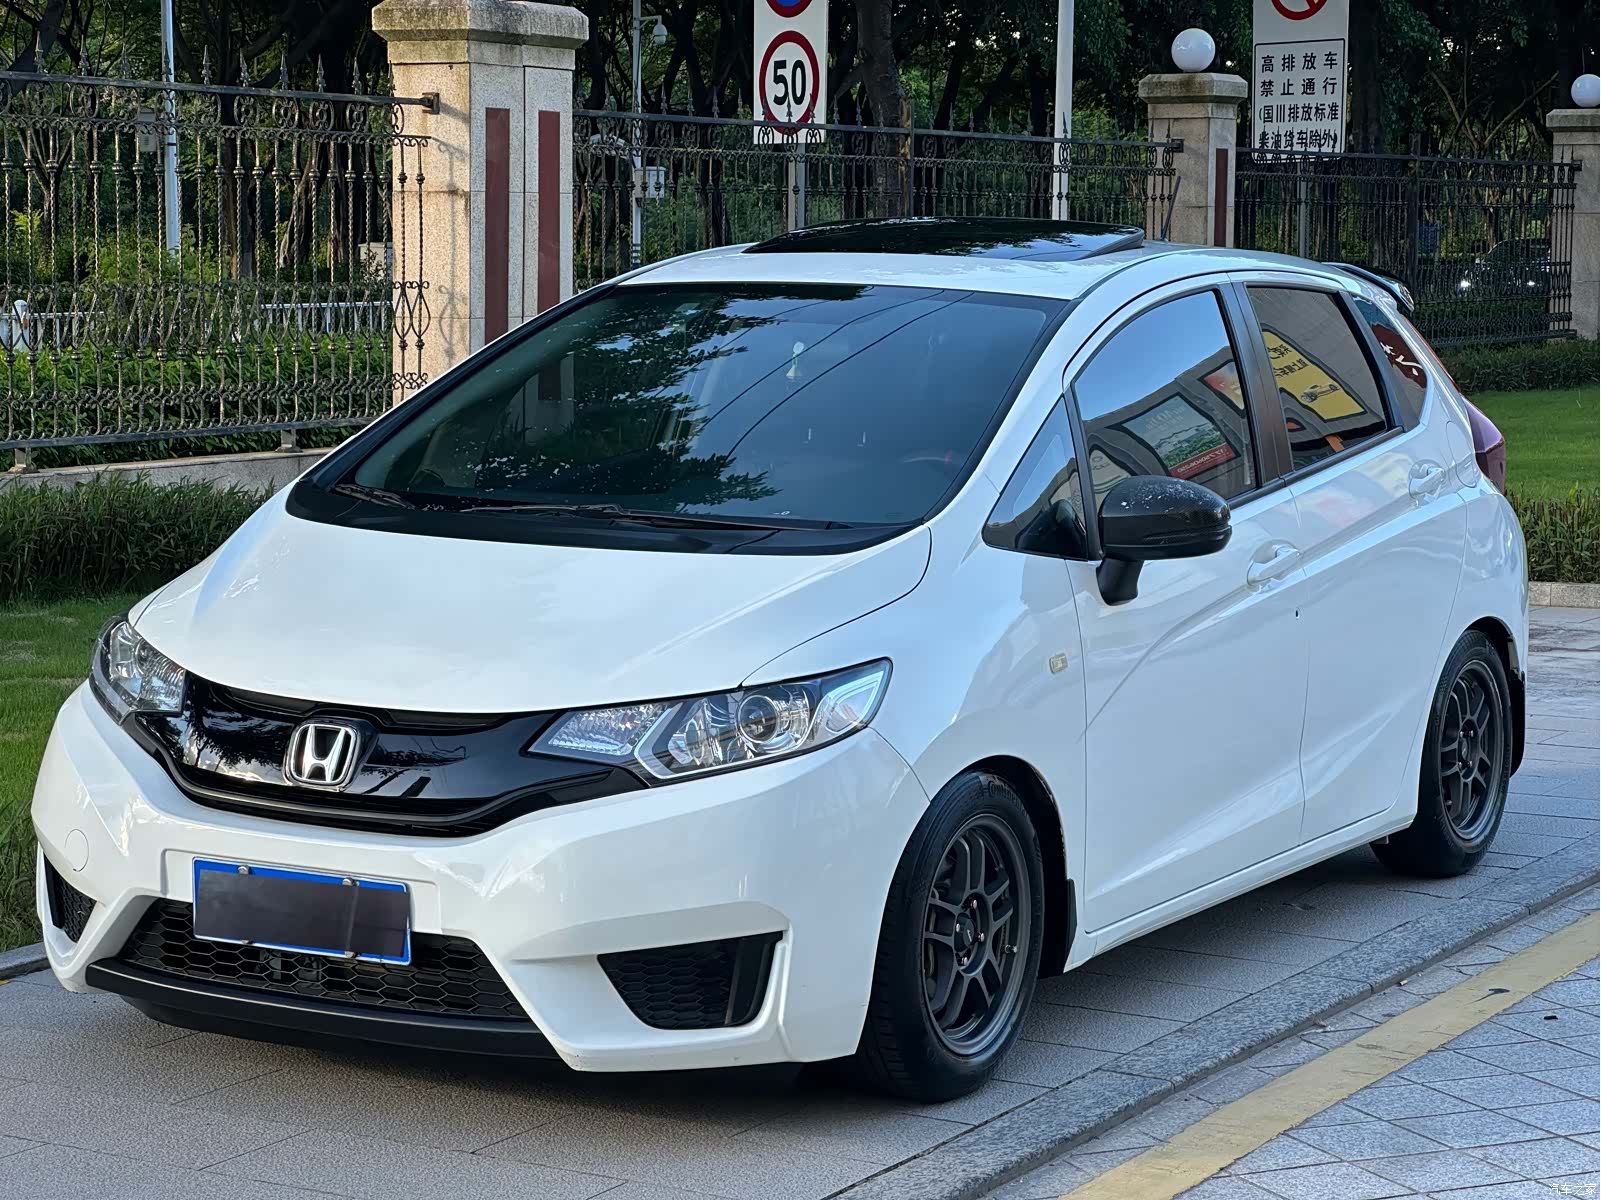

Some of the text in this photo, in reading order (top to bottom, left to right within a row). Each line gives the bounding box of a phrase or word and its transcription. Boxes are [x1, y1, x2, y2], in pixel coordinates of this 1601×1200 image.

[1261, 51, 1338, 73] 高排放车
[773, 59, 807, 106] 50
[1260, 76, 1338, 98] 禁止通行
